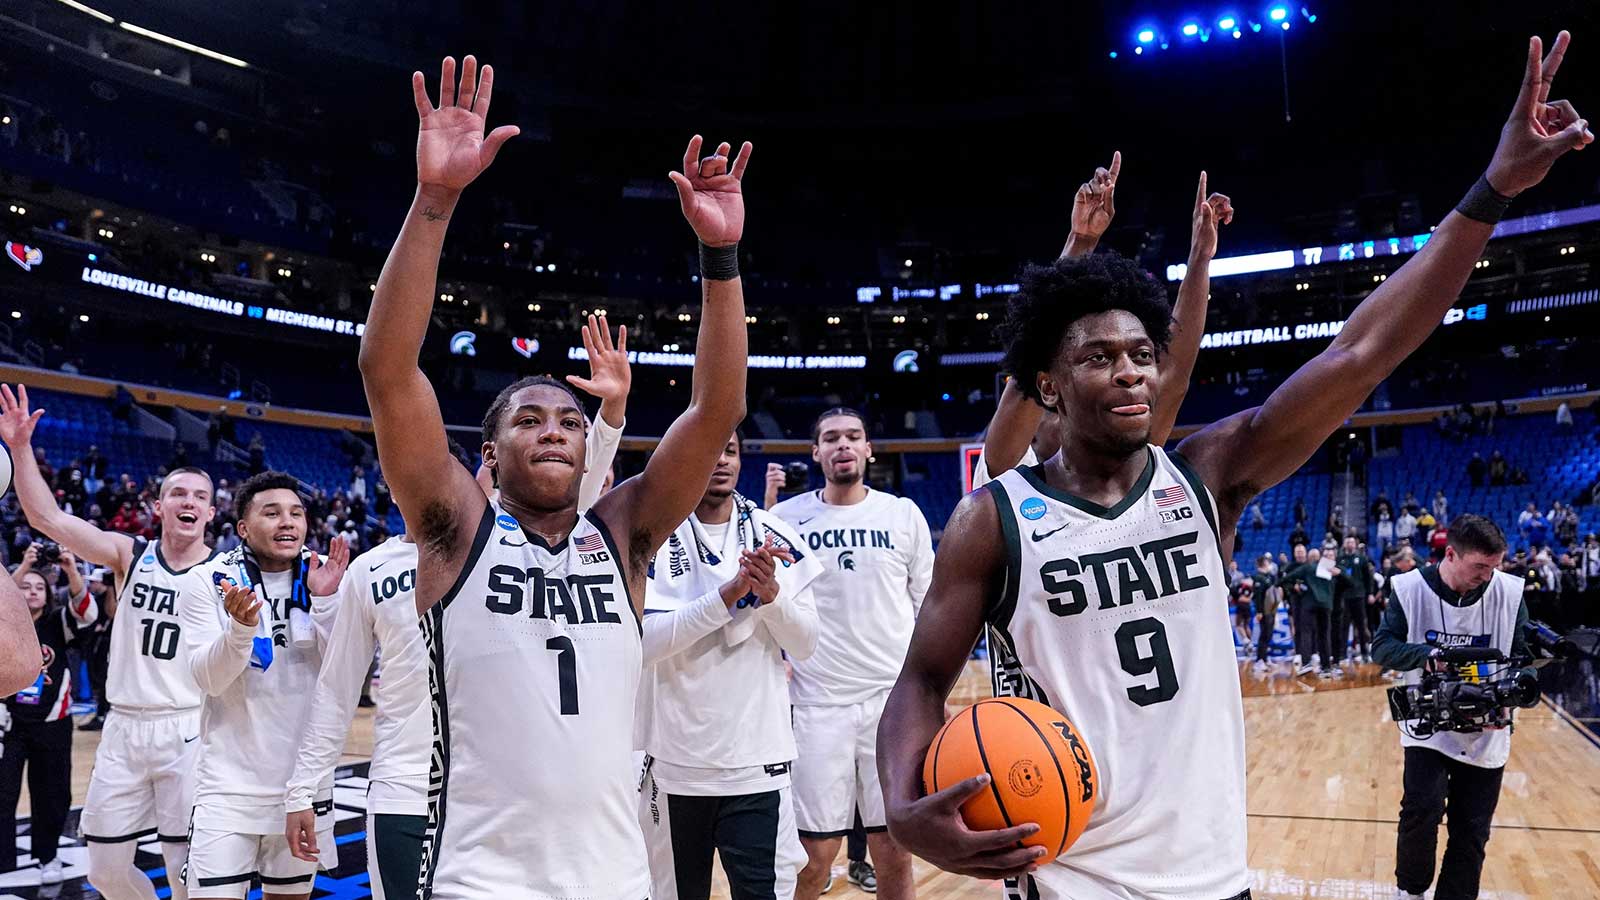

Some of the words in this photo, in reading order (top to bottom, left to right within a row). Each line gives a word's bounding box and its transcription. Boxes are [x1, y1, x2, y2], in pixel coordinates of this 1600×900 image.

[1302, 247, 1323, 265] 77
[82, 267, 167, 299] LOUISVILLE
[167, 288, 244, 316] CARDINALS
[247, 305, 264, 318] VS
[266, 308, 335, 332] MICHIGAN
[335, 320, 354, 335] ST.
[805, 356, 866, 368] SPARTANS
[1200, 326, 1292, 349] ASKETBALL
[800, 529, 847, 551] OCK
[850, 529, 867, 547] IT
[870, 530, 895, 550] IN.
[131, 582, 180, 616] STA
[485, 564, 622, 625] STATE
[1040, 531, 1209, 617] STATE
[141, 618, 181, 660] 10
[1114, 616, 1180, 707] 9
[546, 635, 579, 715] 1
[1052, 721, 1094, 803] NCAA
